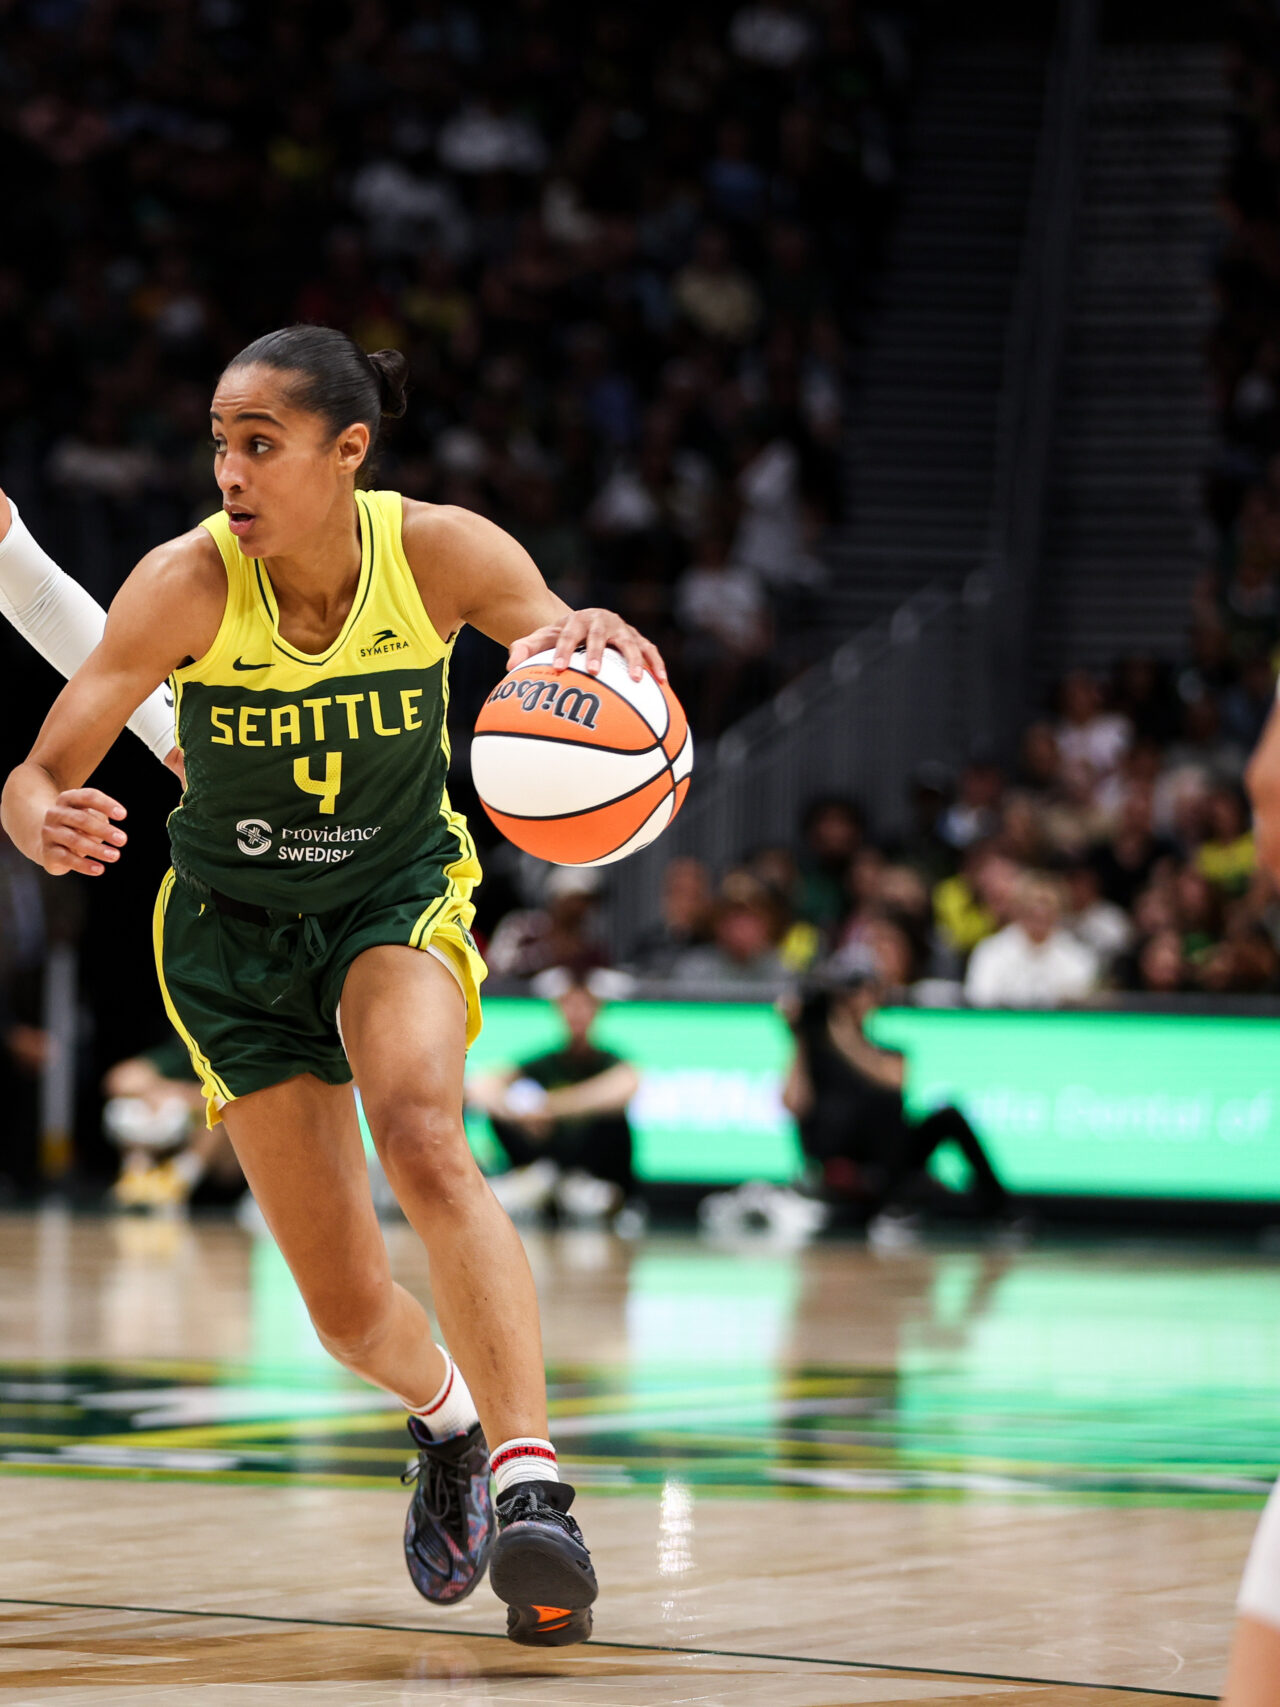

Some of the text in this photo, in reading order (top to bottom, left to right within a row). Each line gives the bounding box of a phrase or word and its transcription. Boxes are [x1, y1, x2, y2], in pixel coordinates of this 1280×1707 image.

[360, 640, 409, 658] SYMETRA
[210, 688, 423, 747] SEATTLE
[293, 751, 342, 815] 4
